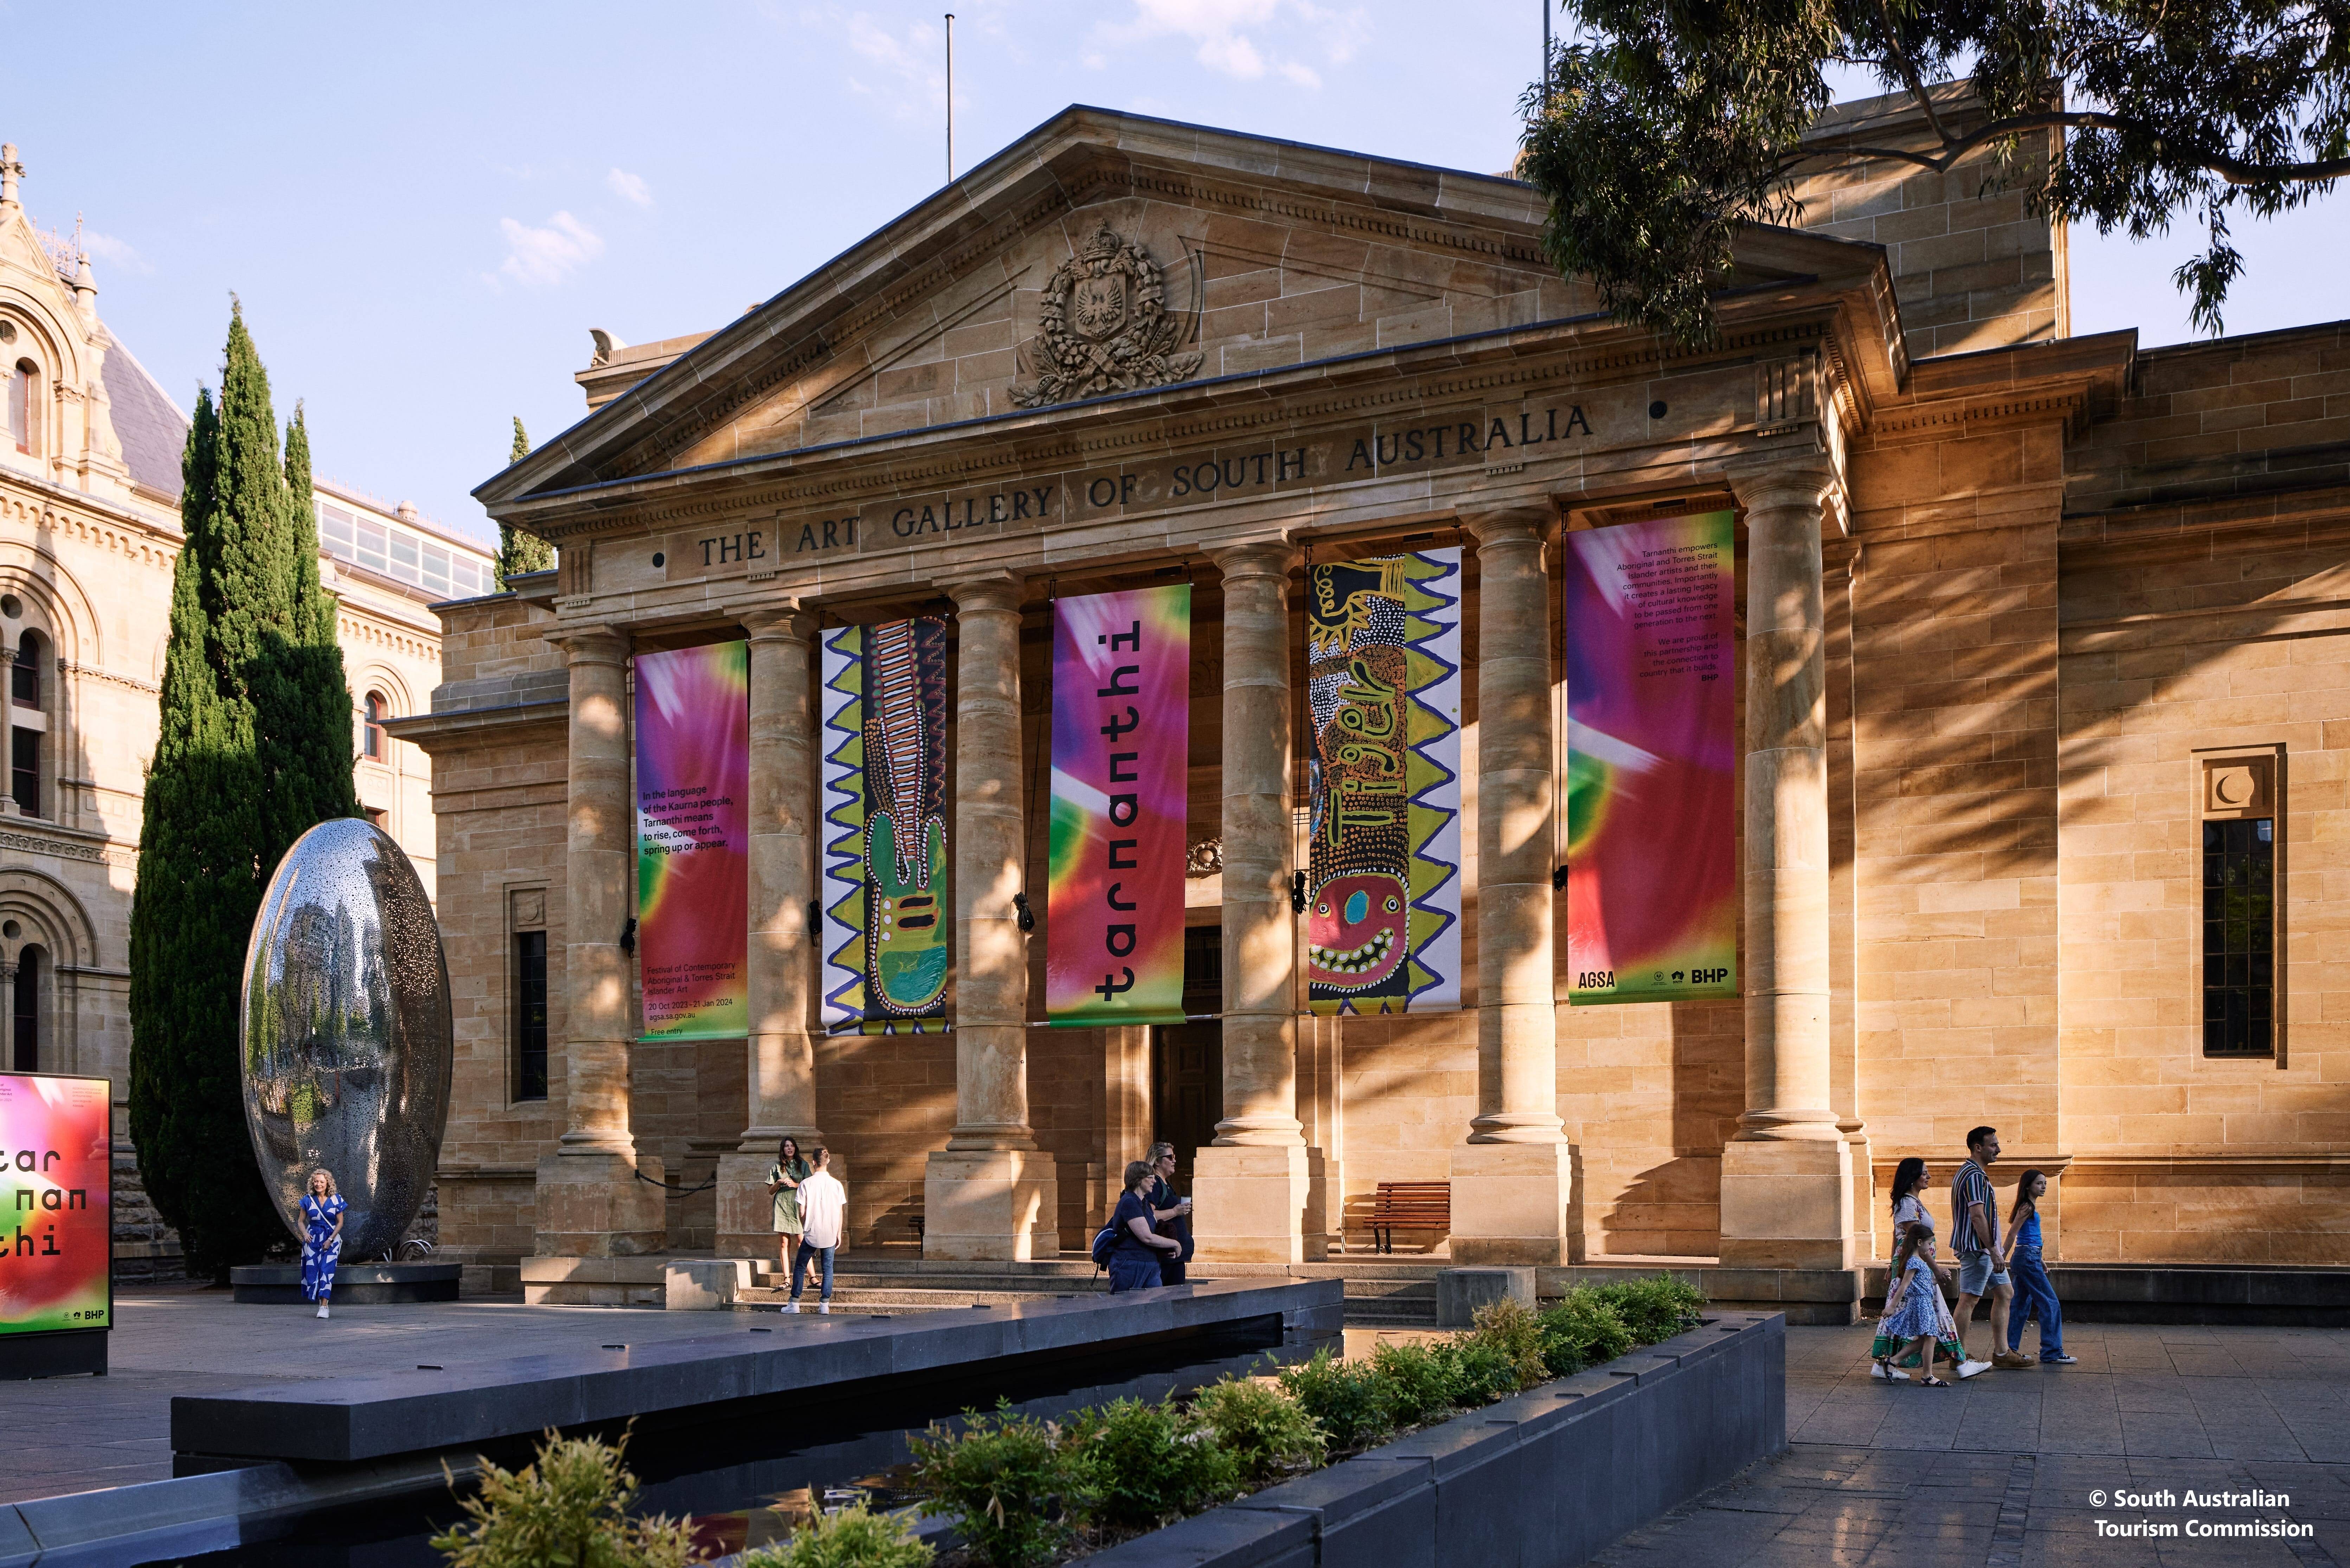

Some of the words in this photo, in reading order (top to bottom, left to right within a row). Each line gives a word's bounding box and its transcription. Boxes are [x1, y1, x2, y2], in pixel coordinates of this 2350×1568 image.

[699, 531, 765, 566] THE
[796, 516, 860, 552] ART
[893, 486, 1053, 537] GALLERY
[1089, 474, 1137, 507] OF
[1173, 447, 1306, 496] SOUTH
[1345, 405, 1593, 471] AUSTRALIA
[1643, 547, 1676, 558] Tarnanthi
[1678, 543, 1717, 553] empowers
[1617, 560, 1654, 571] Aboriginal
[1698, 552, 1717, 560] Strait
[1623, 579, 1672, 590] communities.
[1675, 572, 1718, 583] Importantly
[1628, 571, 1657, 579] Islander
[1631, 590, 1658, 599] creates
[1667, 586, 1691, 595] lasting
[1648, 598, 1674, 607] cultural
[1677, 592, 1718, 603] knowledge
[1656, 606, 1682, 617] passed
[1684, 604, 1701, 612] from
[1634, 618, 1673, 630] generation
[1687, 633, 1708, 643] proud
[1644, 649, 1657, 657] this
[1659, 645, 1701, 656] partnership
[1667, 654, 1708, 664] connection
[1640, 669, 1667, 677] country
[643, 792, 650, 801] In
[652, 790, 666, 799] the
[668, 786, 707, 798] language
[643, 805, 651, 814] of
[653, 804, 666, 813] the
[668, 802, 698, 811] Kaurna
[700, 796, 733, 809] people,
[1095, 620, 1141, 1002] tarnanthi
[644, 815, 682, 827] Tarnanthi
[685, 814, 713, 823] means
[654, 831, 671, 840] rise,
[673, 829, 696, 838] come
[698, 825, 722, 835] forth,
[644, 845, 670, 856] spring
[672, 844, 682, 853] up
[695, 840, 728, 851] appear.
[648, 966, 672, 974] Festival
[683, 963, 735, 972] Contemporary
[648, 975, 682, 985] Aboriginal
[1578, 971, 1615, 989] AGSA
[1691, 968, 1728, 984] BHP
[648, 987, 675, 995] Islander
[649, 1013, 695, 1022] agsa.sa.gov.au
[16, 1189, 86, 1210] nan
[85, 1310, 104, 1319] BHP
